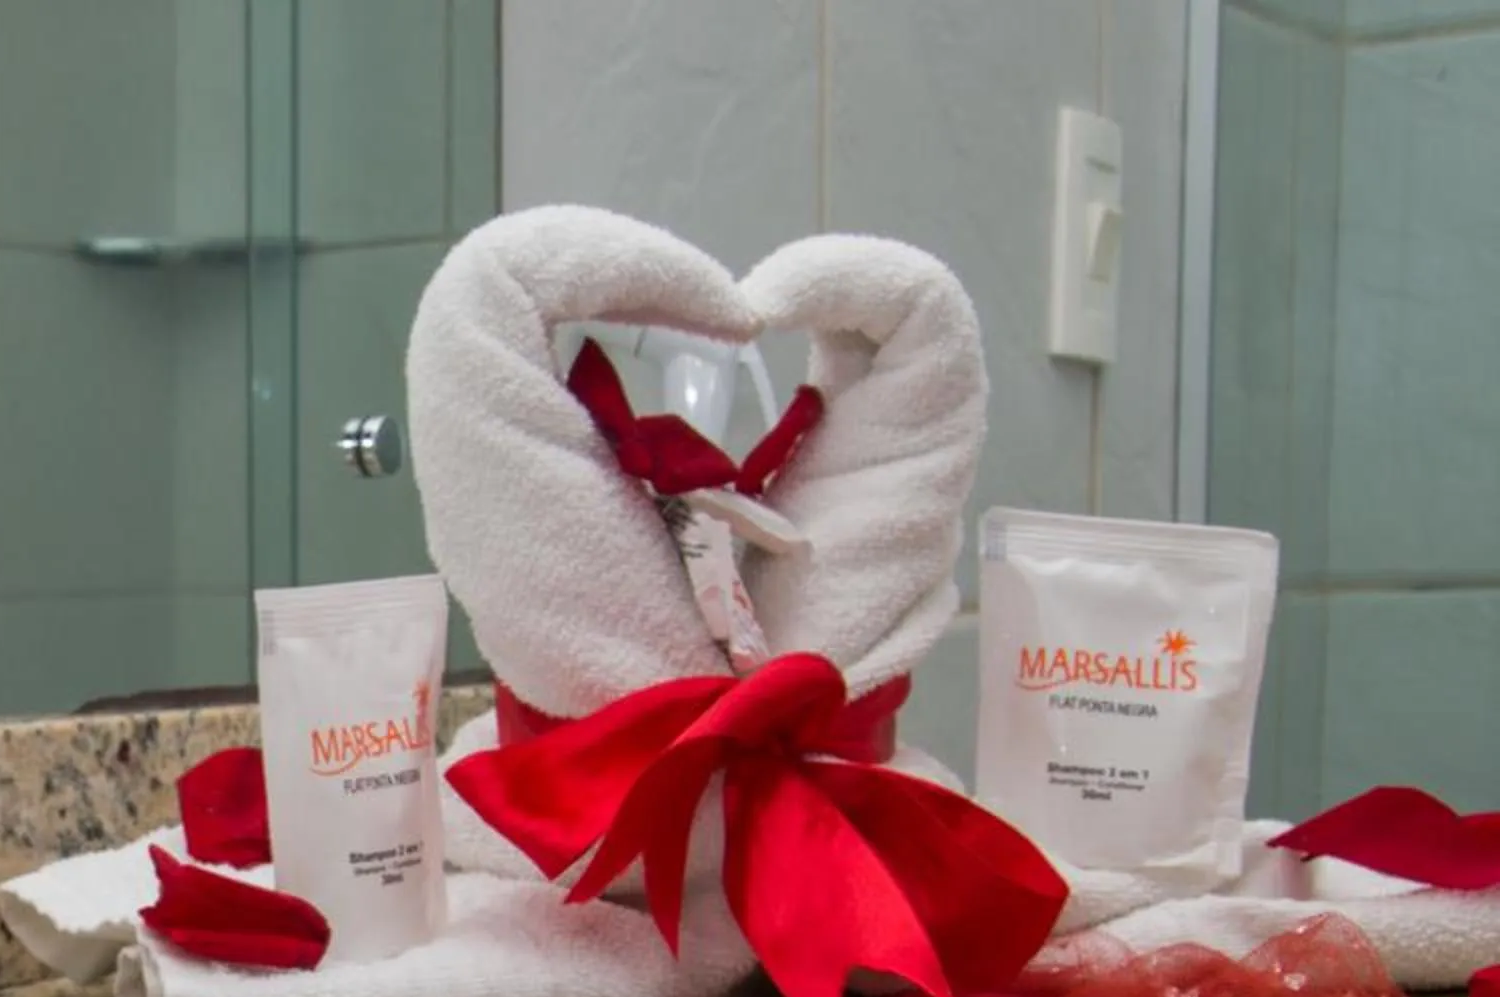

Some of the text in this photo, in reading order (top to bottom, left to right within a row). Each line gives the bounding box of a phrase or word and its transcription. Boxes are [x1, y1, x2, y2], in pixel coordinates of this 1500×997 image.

[1016, 646, 1197, 691] MARSALLIS
[1049, 695, 1158, 718] FLAT PONTA NEGRA
